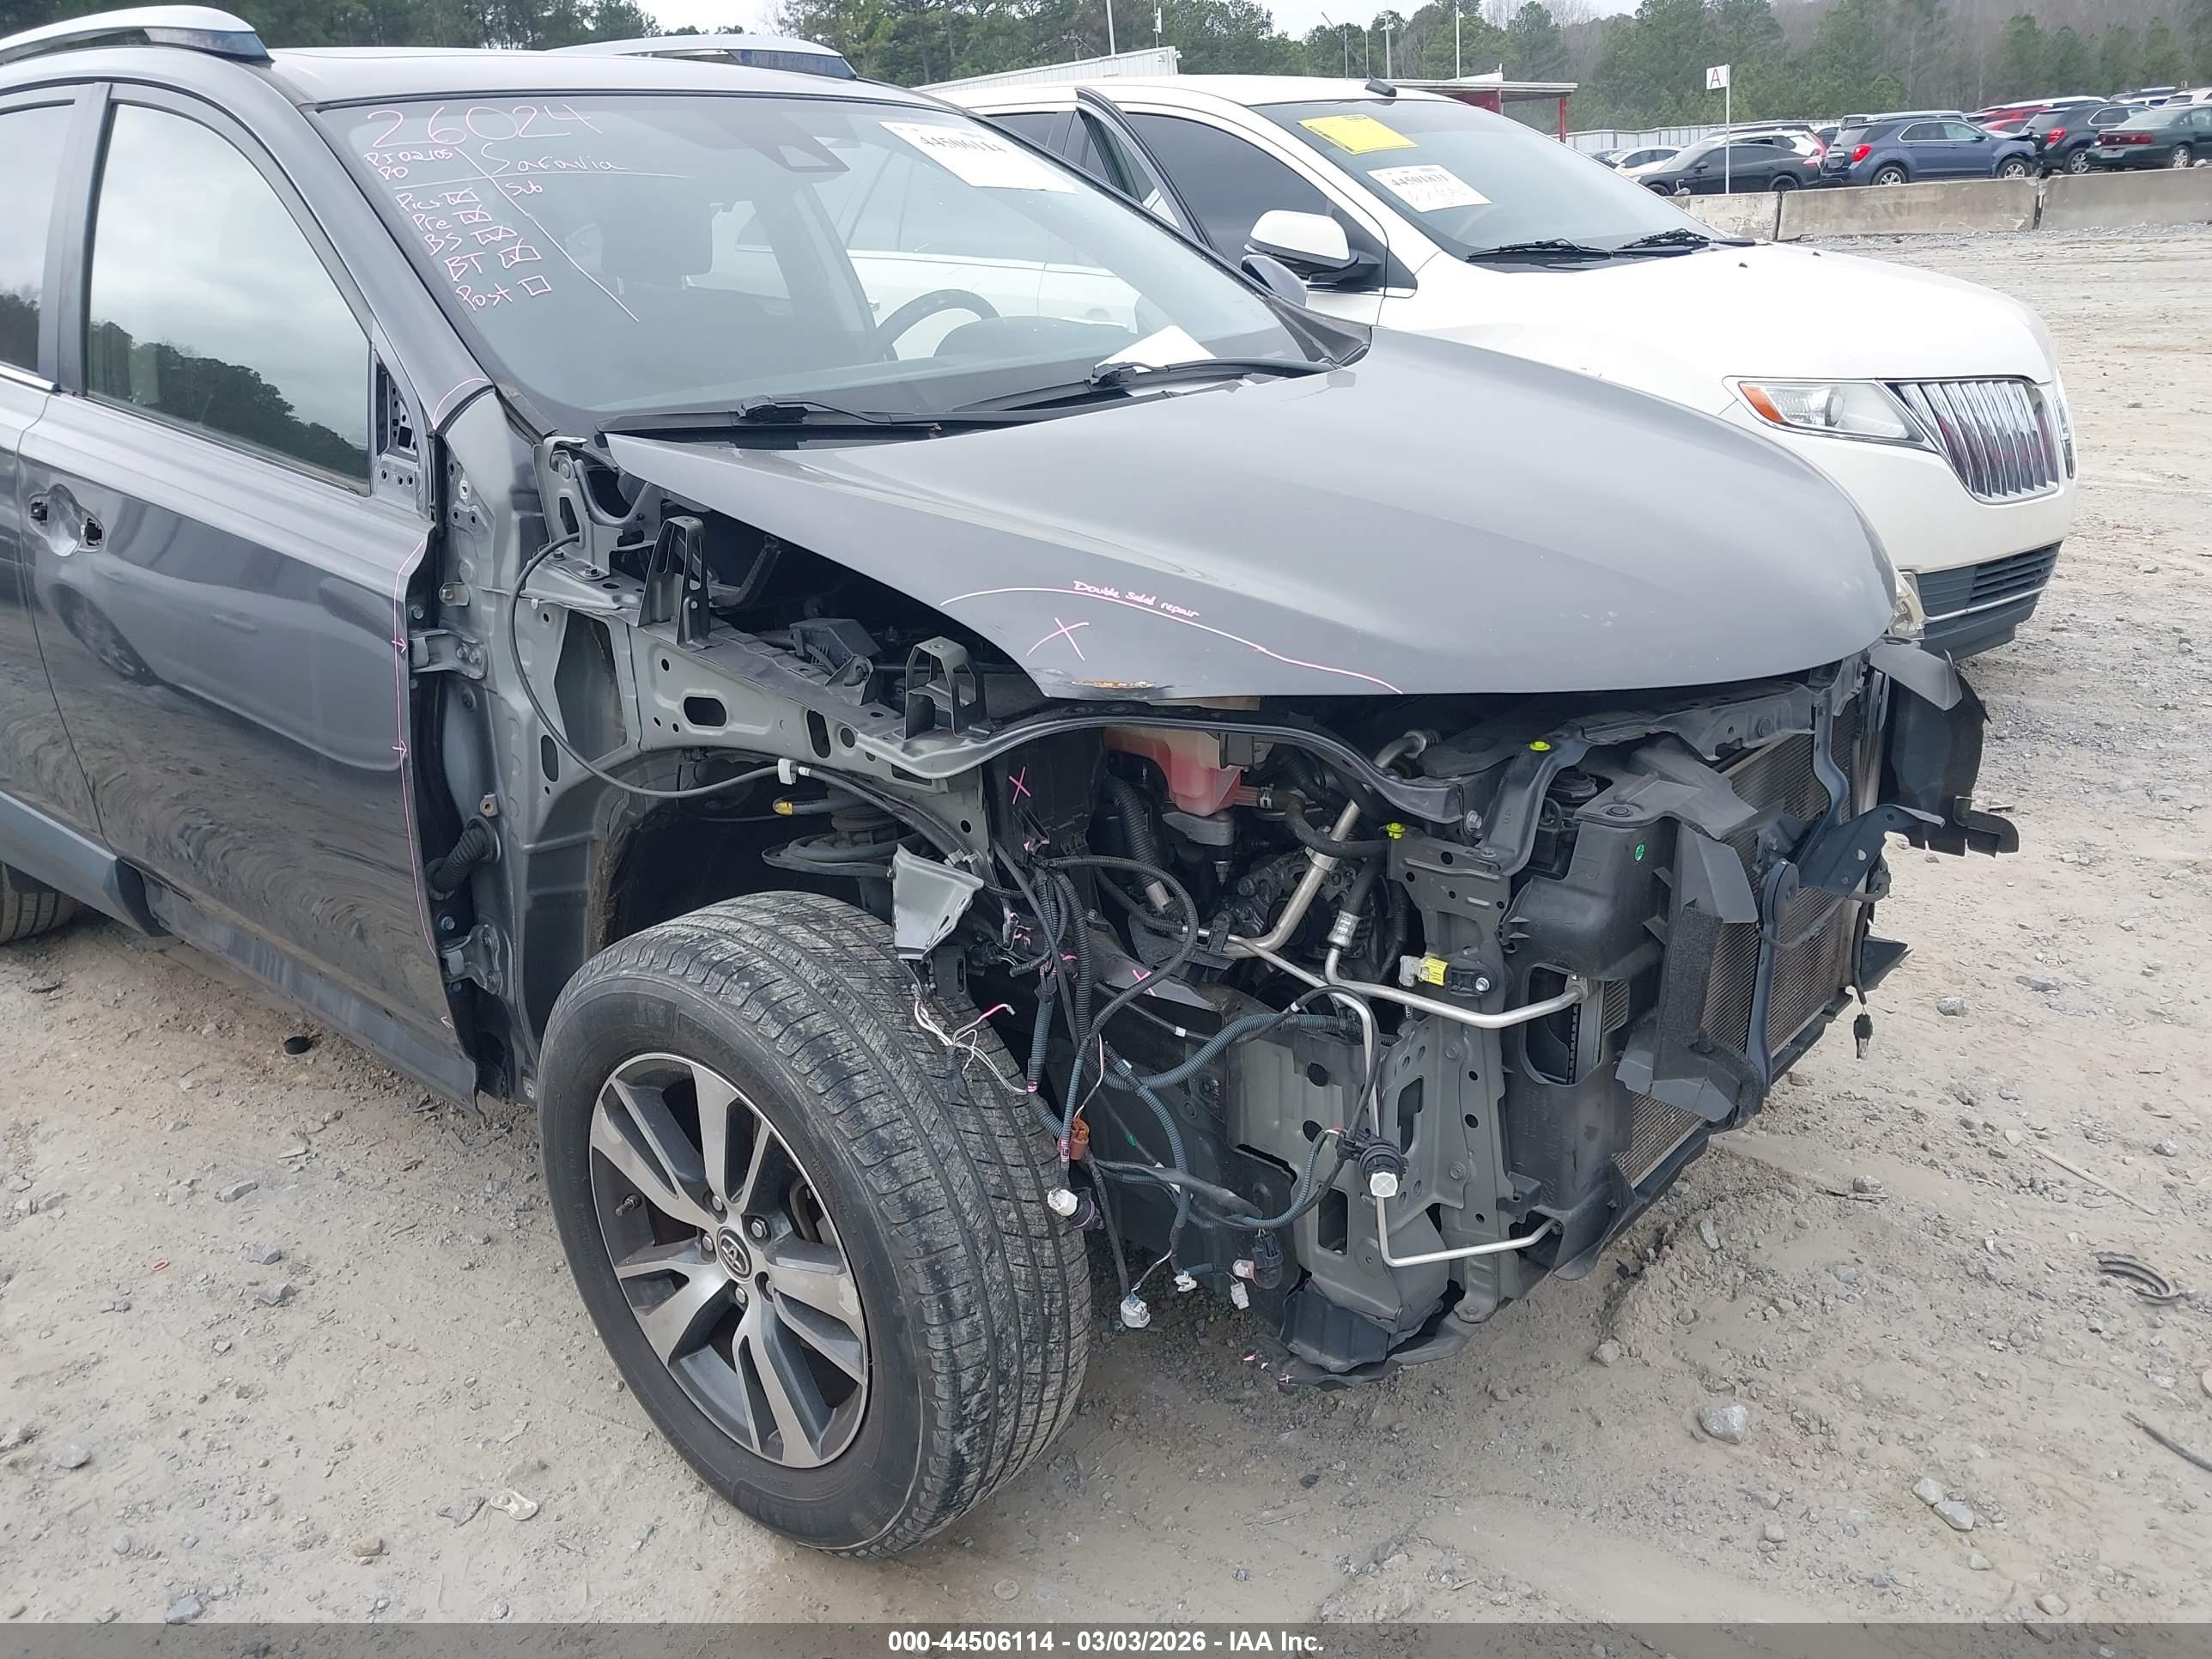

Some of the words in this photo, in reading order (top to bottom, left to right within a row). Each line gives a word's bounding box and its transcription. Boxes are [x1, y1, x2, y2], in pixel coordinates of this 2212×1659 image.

[1710, 68, 1722, 88] A
[367, 103, 602, 149] 26024
[412, 213, 453, 233] Pre
[443, 252, 486, 283] BT
[455, 283, 514, 312] Post
[1073, 580, 1120, 599] Double
[1160, 602, 1200, 617] repair
